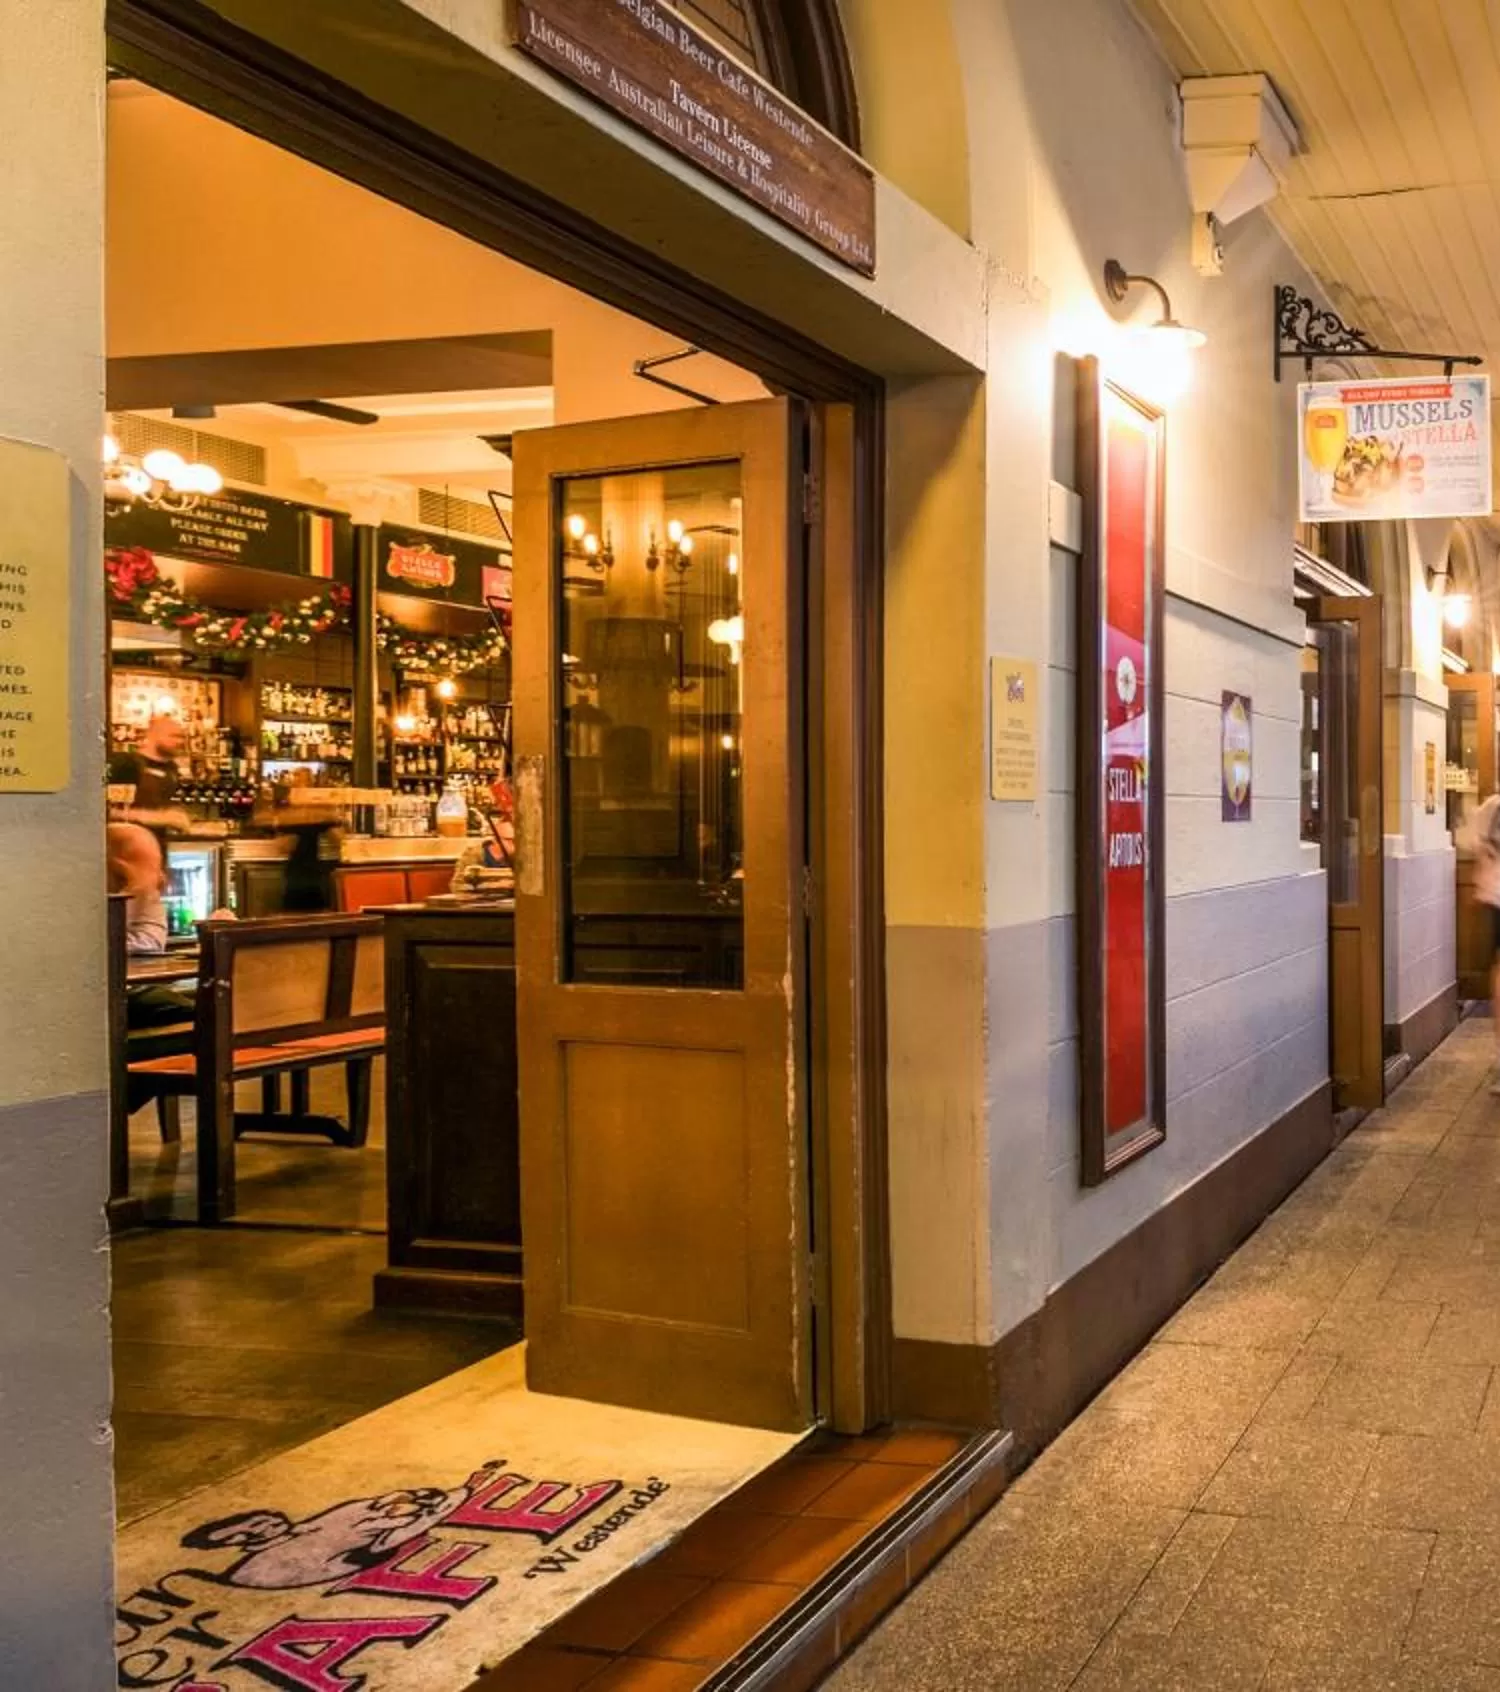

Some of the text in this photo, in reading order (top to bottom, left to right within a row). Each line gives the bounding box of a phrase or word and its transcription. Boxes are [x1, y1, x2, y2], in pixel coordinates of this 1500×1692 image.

[679, 28, 715, 75] Beer
[717, 60, 750, 98] Cafe
[752, 85, 813, 147] Westende
[529, 11, 602, 81] Licensee
[607, 67, 684, 136] Australian
[687, 121, 734, 168] Leisure
[737, 158, 749, 179] &
[751, 164, 810, 225] Hospitality
[815, 209, 850, 251] Group
[668, 78, 773, 171] Tavern License
[1354, 399, 1473, 433] MUSSELS
[1400, 419, 1478, 446] STELLA
[1109, 767, 1143, 802] STELLA
[1109, 832, 1143, 868] ARTOIS
[172, 1472, 625, 1692] AFE
